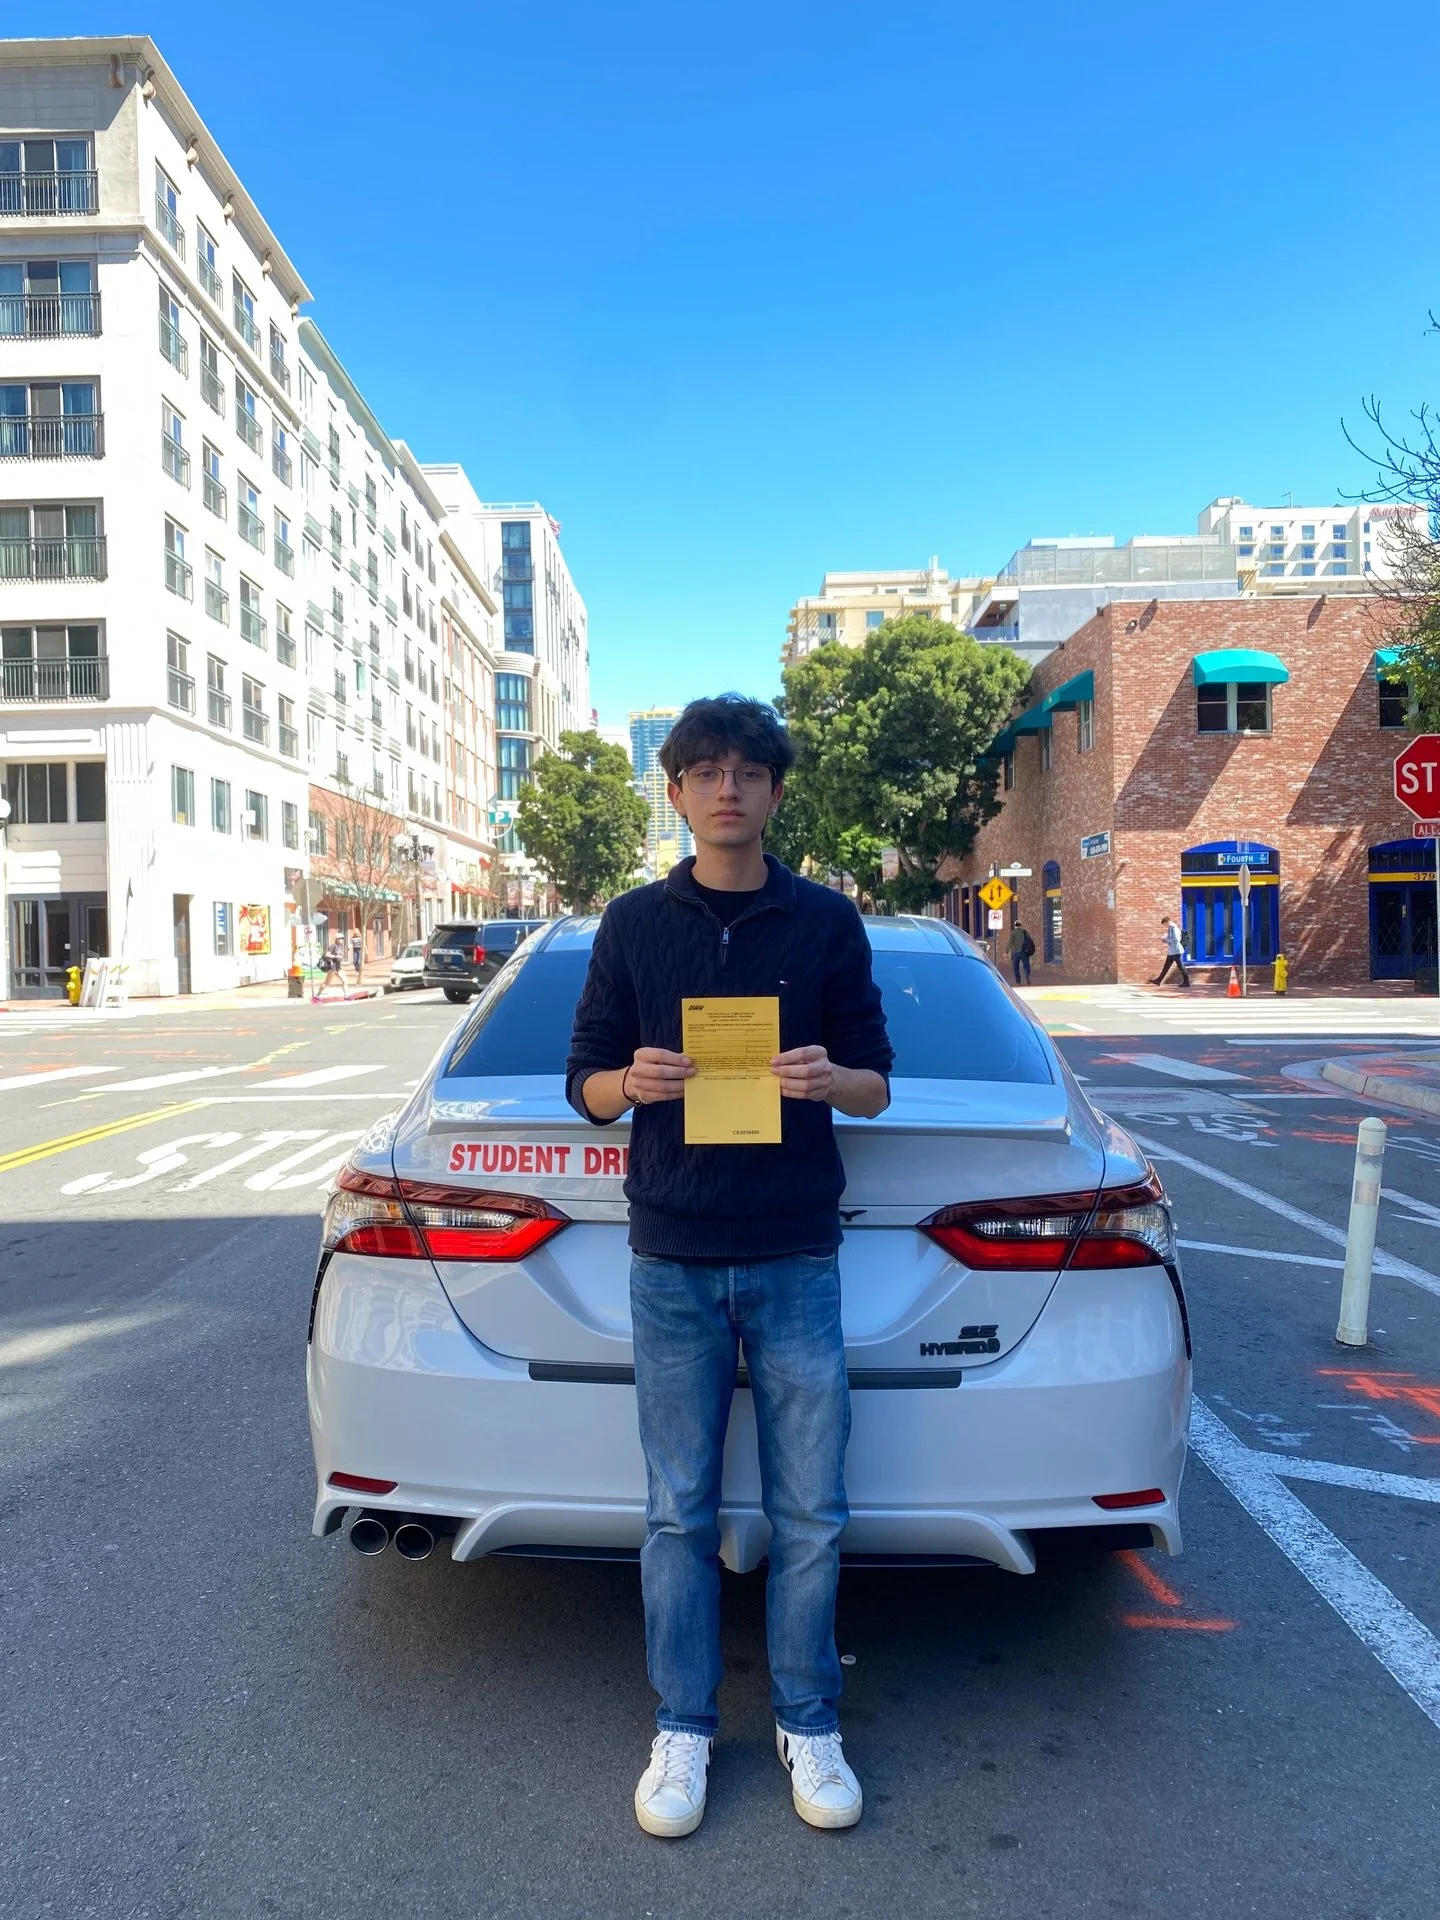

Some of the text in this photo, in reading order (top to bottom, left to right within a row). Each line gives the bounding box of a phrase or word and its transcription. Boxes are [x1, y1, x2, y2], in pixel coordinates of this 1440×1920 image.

[1401, 762, 1438, 794] ST
[1413, 872, 1436, 881] 379
[60, 1129, 368, 1196] STO
[450, 1143, 571, 1174] STUDENT
[959, 1324, 999, 1339] SE
